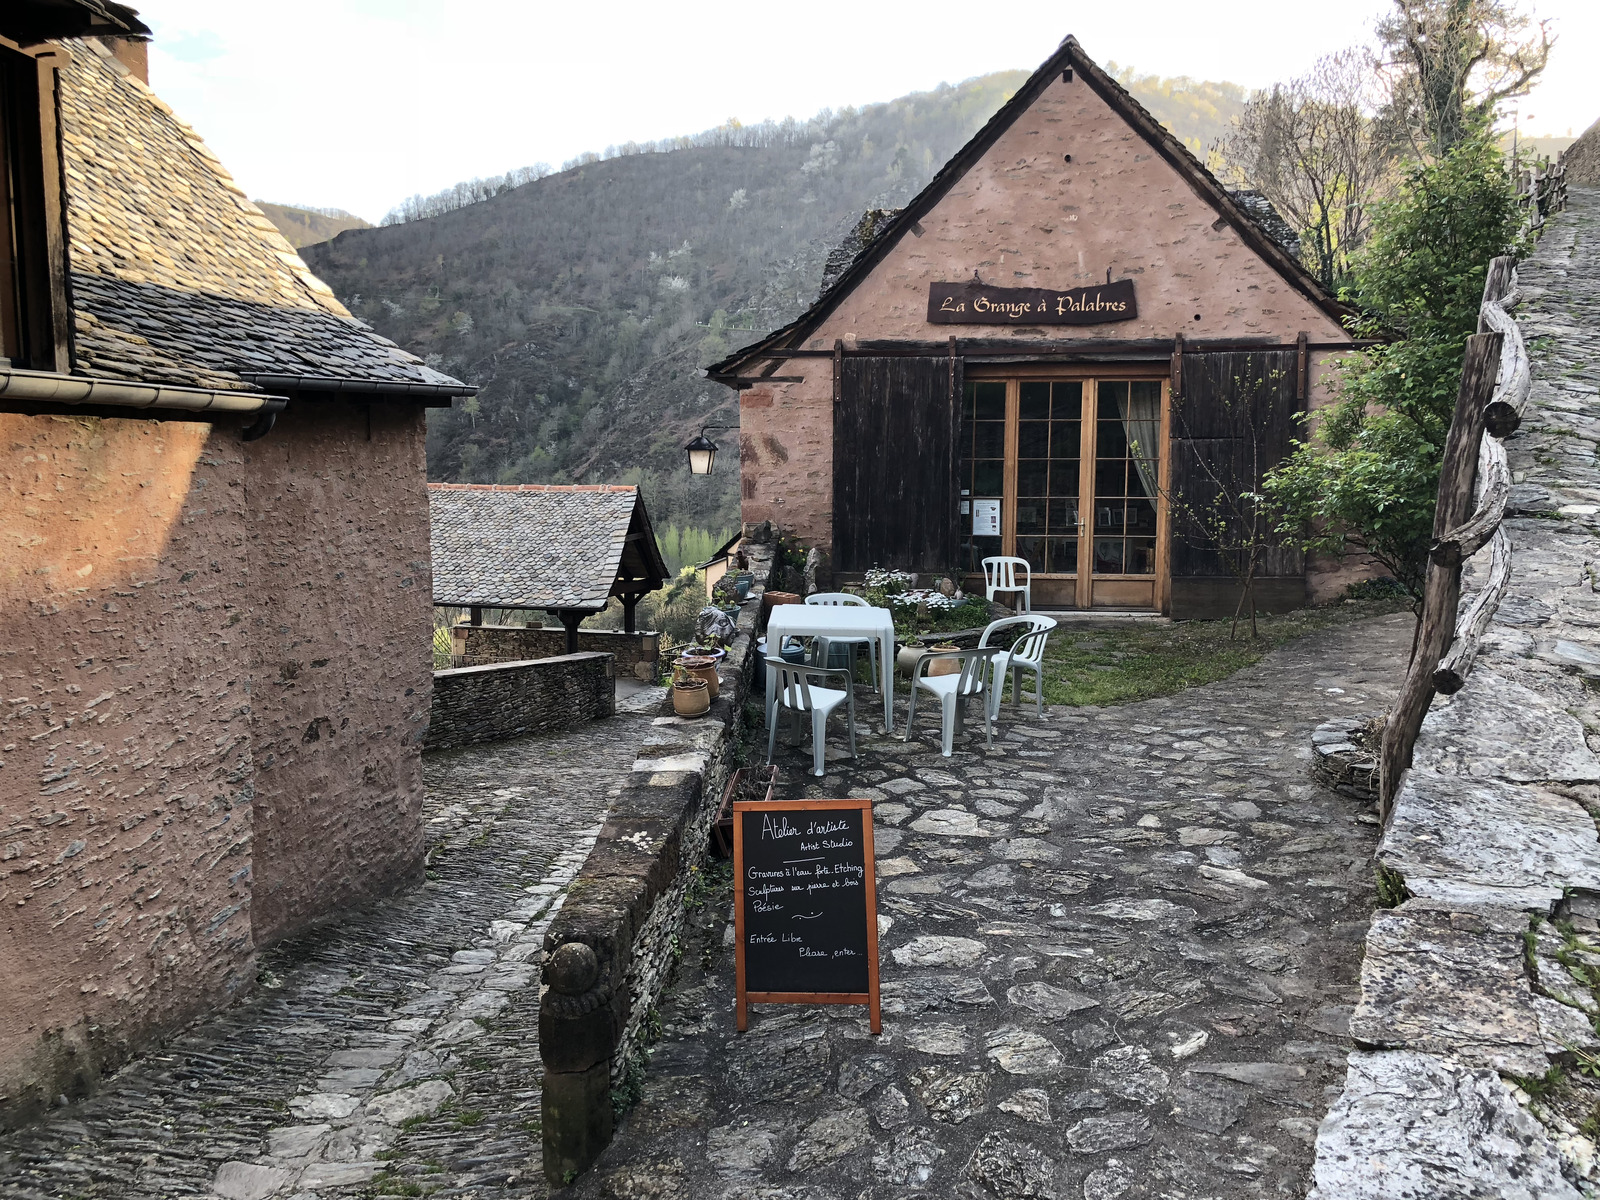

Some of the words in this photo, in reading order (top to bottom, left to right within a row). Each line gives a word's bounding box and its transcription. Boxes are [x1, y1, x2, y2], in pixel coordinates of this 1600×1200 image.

[939, 296, 965, 313] La
[973, 296, 1031, 318] Grange
[1037, 299, 1047, 313] à
[1055, 292, 1127, 316] Palabres
[761, 813, 802, 840] Atelier
[806, 819, 850, 836] d'artiste
[800, 841, 820, 852] Artist
[822, 838, 854, 849] Studio
[747, 866, 785, 880] Gravures
[747, 883, 785, 902] Sculptures
[806, 881, 830, 896] pierre
[831, 879, 841, 888] et
[841, 877, 859, 887] bois
[752, 899, 784, 913] Poésie
[749, 932, 778, 944] Entrée
[798, 946, 828, 958] Please
